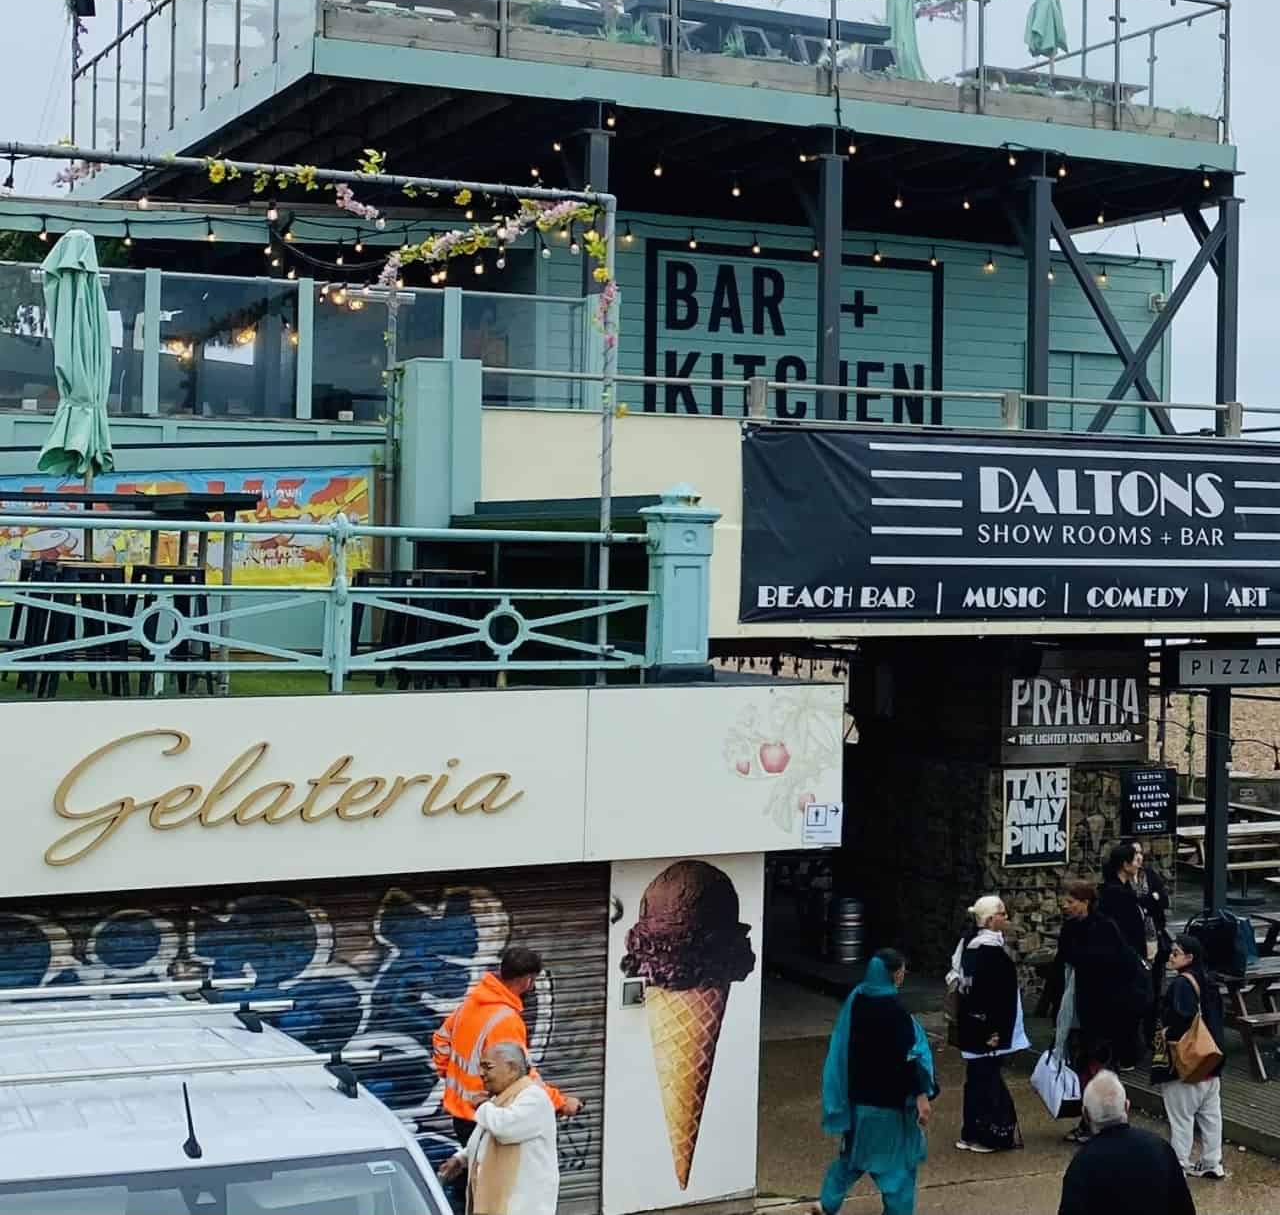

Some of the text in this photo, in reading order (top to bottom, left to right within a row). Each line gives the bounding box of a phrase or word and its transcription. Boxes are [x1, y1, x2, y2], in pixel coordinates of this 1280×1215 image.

[665, 260, 878, 335] BAR +
[979, 466, 1225, 518] DALTONS
[978, 524, 1053, 544] SHOW
[1062, 524, 1151, 546] ROOMS
[1180, 528, 1225, 546] BAR
[757, 585, 852, 608] BEACH
[860, 587, 916, 608] BAR
[962, 587, 1047, 608] MUSIC
[1086, 586, 1189, 608] COMEDY
[1225, 587, 1270, 608] ART
[1011, 678, 1140, 726] PRAVHA
[1019, 734, 1032, 745] THE
[1035, 733, 1067, 745] LIGHTER
[1069, 732, 1099, 744] TASTING
[44, 727, 525, 867] Gelateria
[1007, 772, 1067, 799] TAKE
[1007, 799, 1066, 825] AWAY
